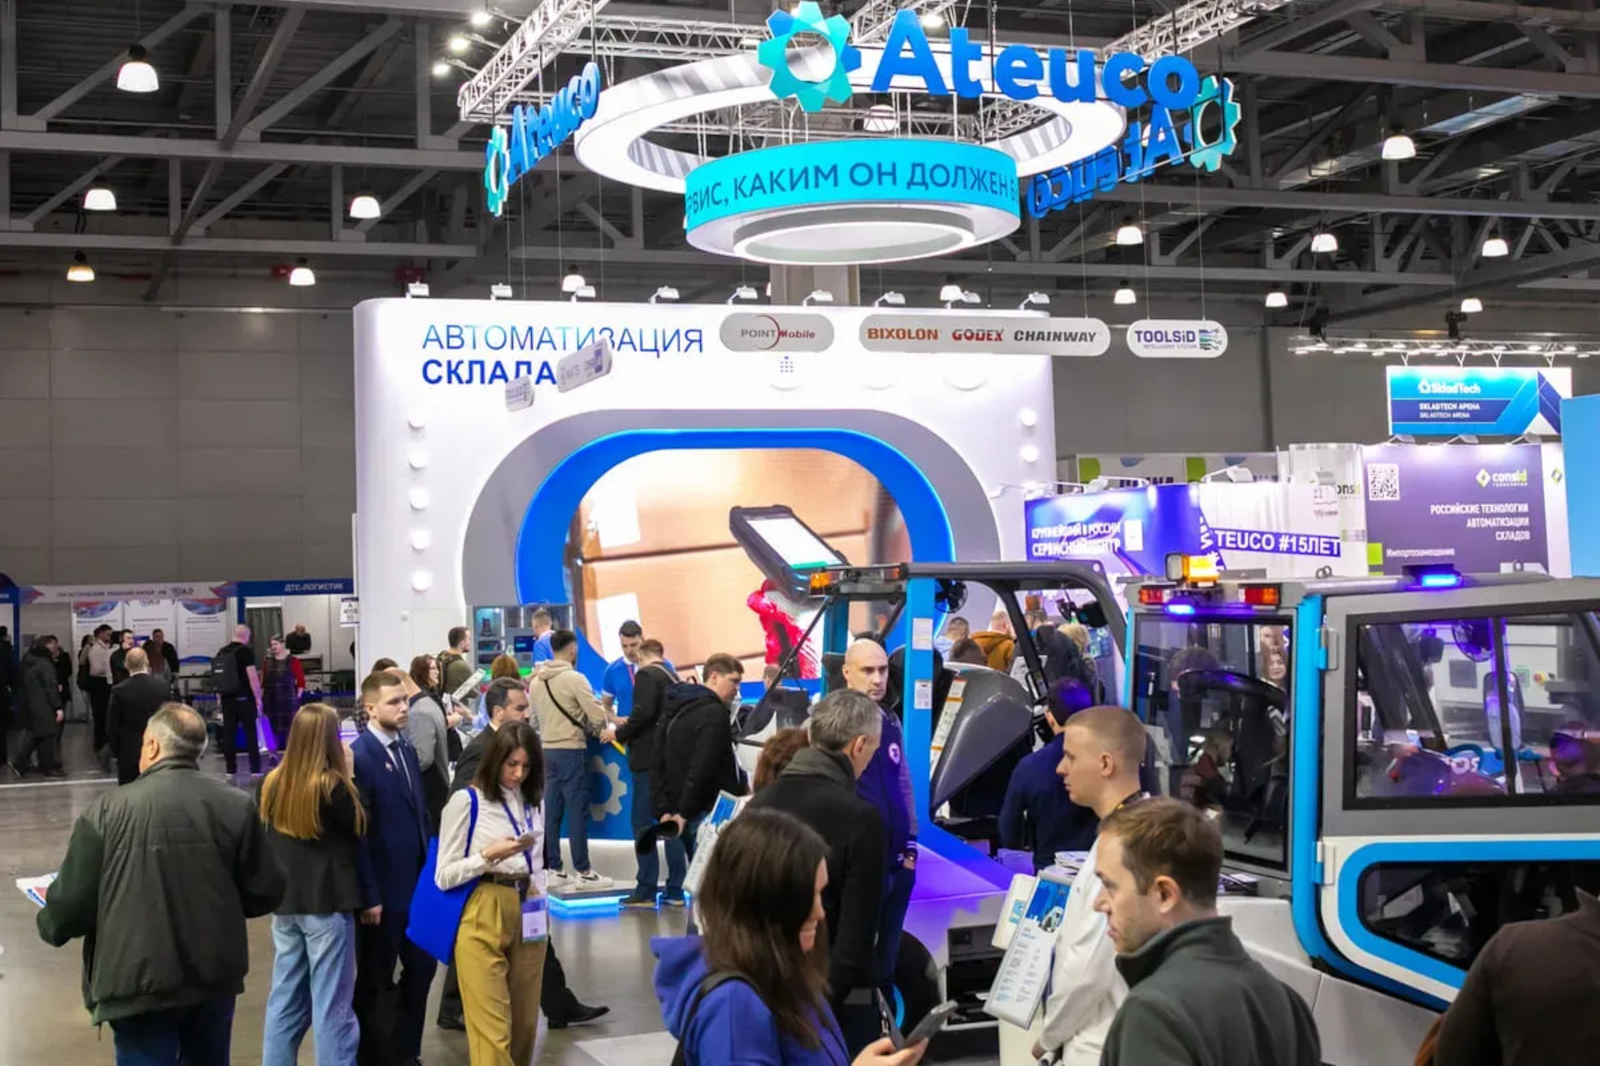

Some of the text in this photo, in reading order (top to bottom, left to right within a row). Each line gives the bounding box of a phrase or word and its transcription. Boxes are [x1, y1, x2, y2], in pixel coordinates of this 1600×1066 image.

[869, 9, 1200, 110] Ateuco
[507, 62, 600, 186] Ateuco
[733, 164, 839, 200] КАКИМ
[849, 162, 897, 187] ОН
[906, 162, 1008, 199] ДОЛЖЕН
[422, 325, 704, 358] АВТОМАТИЗАЦИЯ
[740, 329, 816, 339] POINT Mobile
[867, 328, 1097, 343] BIXOLON GODEX CHAINWAY
[422, 359, 557, 385] СКЛАДА
[1492, 469, 1528, 482] consid
[1430, 502, 1529, 514] РОССИЙСКИЕ ТЕХНОЛОГИИ
[1466, 517, 1530, 528] АВТОМАТИЗАЦИИ
[1214, 530, 1341, 555] TEUCO #15ЛЕТ
[1495, 531, 1530, 541] СКЛАДОВ
